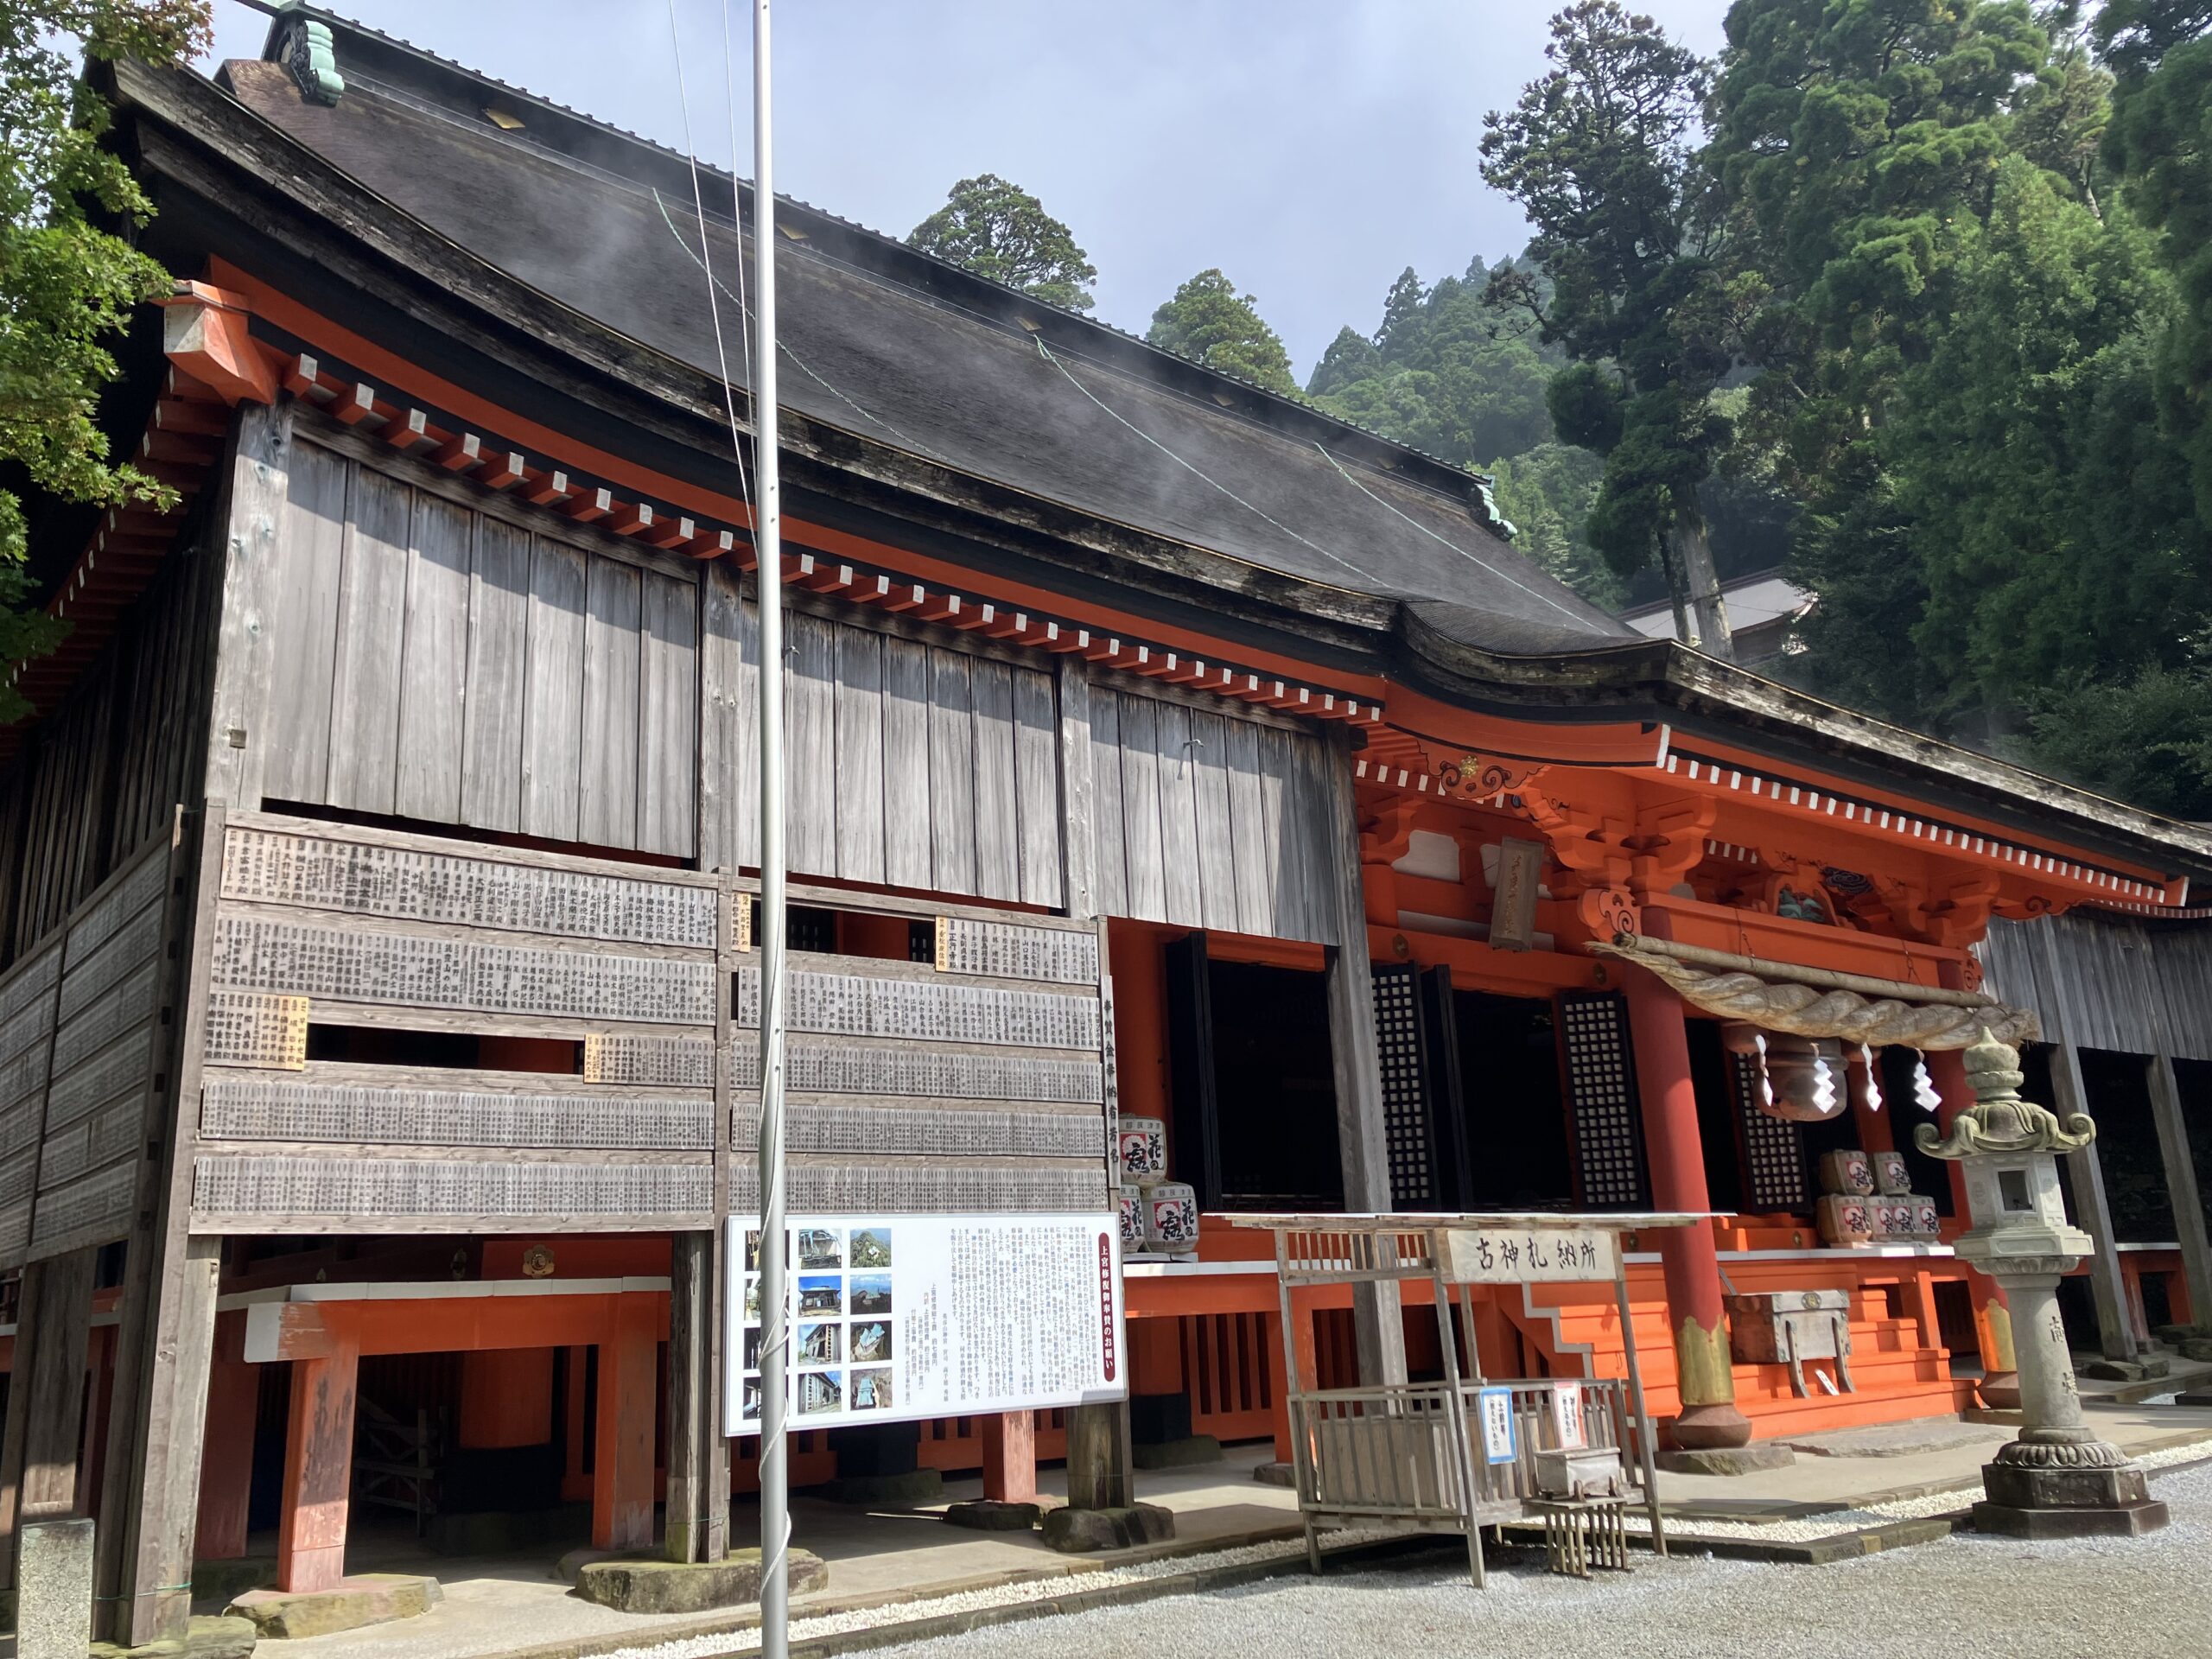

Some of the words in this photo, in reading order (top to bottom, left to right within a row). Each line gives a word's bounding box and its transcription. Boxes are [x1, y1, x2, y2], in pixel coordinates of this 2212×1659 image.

[1476, 1236, 1596, 1270] 古神札納所
[1101, 1246, 1113, 1369] 上宮修復御奉賛のお願い
